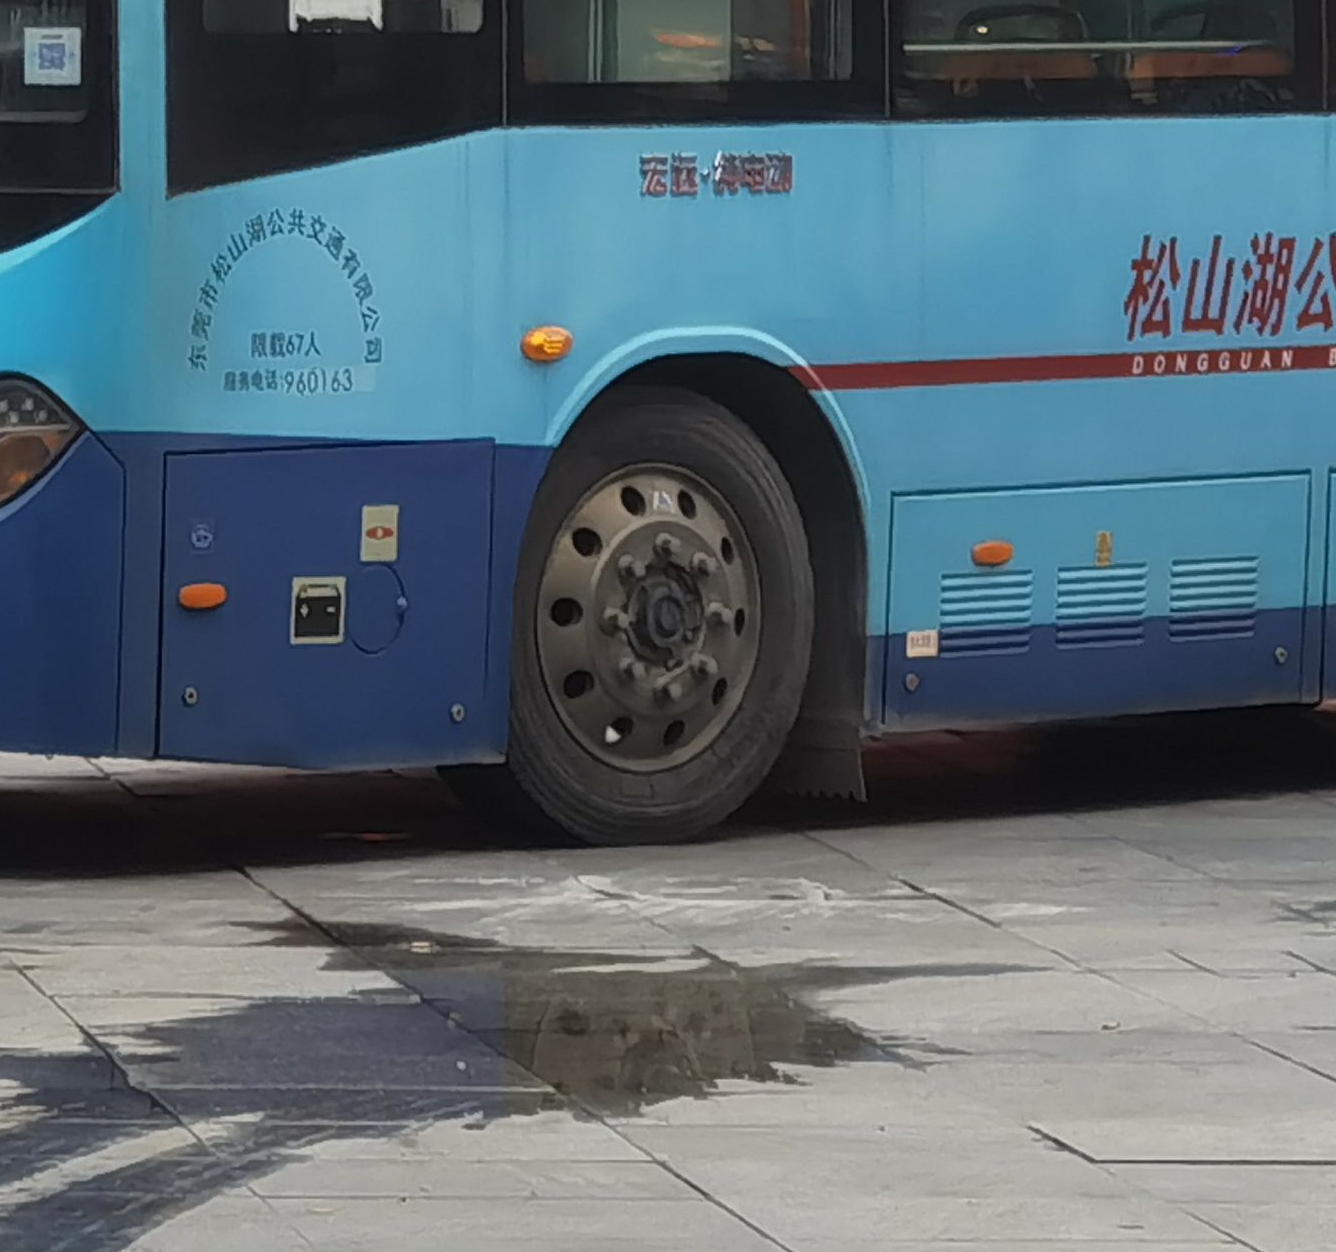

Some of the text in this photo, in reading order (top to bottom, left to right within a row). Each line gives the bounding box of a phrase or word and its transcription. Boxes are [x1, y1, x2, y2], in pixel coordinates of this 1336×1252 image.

[187, 207, 383, 373] 东莞市松山湖公共交通有限公司
[250, 331, 322, 359] 限载67人
[1132, 349, 1294, 375] DONGGUAN
